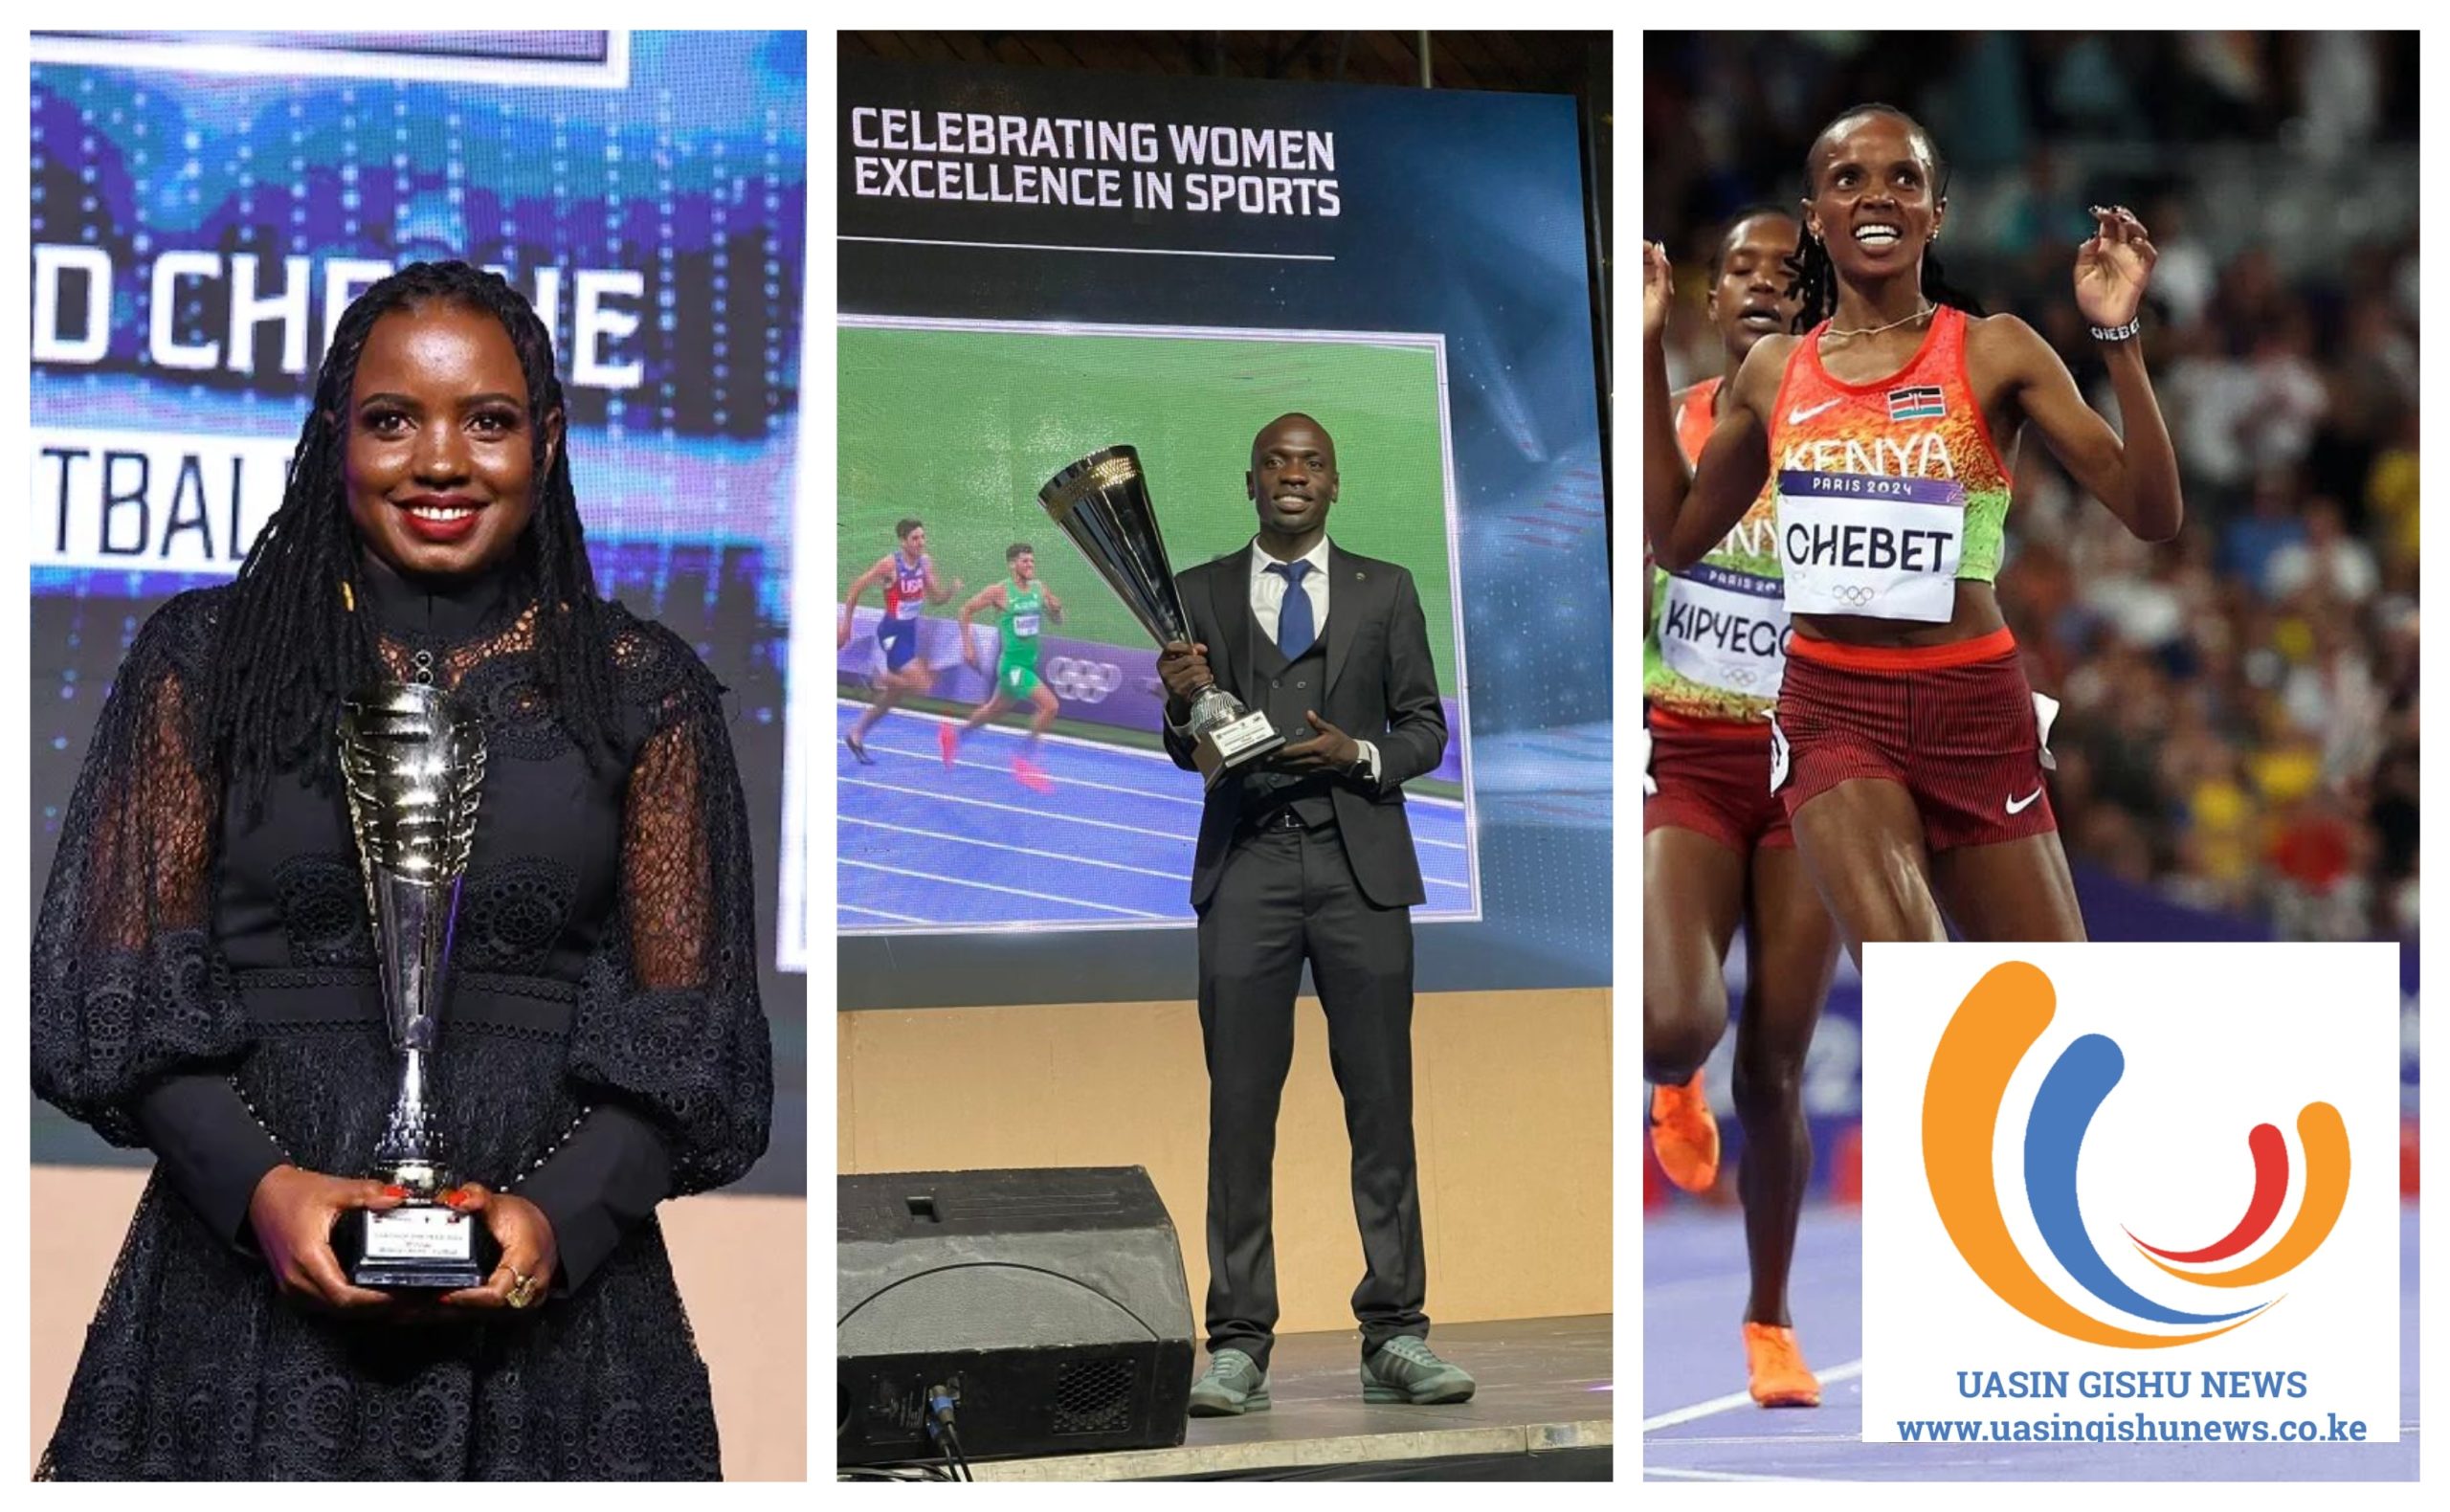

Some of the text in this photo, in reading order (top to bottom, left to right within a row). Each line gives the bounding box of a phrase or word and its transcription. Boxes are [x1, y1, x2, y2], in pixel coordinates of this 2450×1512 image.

[852, 107, 1335, 171] CELEBRATING WOMEN
[855, 156, 1341, 217] EXCELLENCE IN SPORTS
[40, 447, 293, 561] TBAL
[1813, 477, 1912, 496] PARIS 2024
[1786, 523, 1954, 572] CHEBET
[1708, 568, 1752, 590] PARIS
